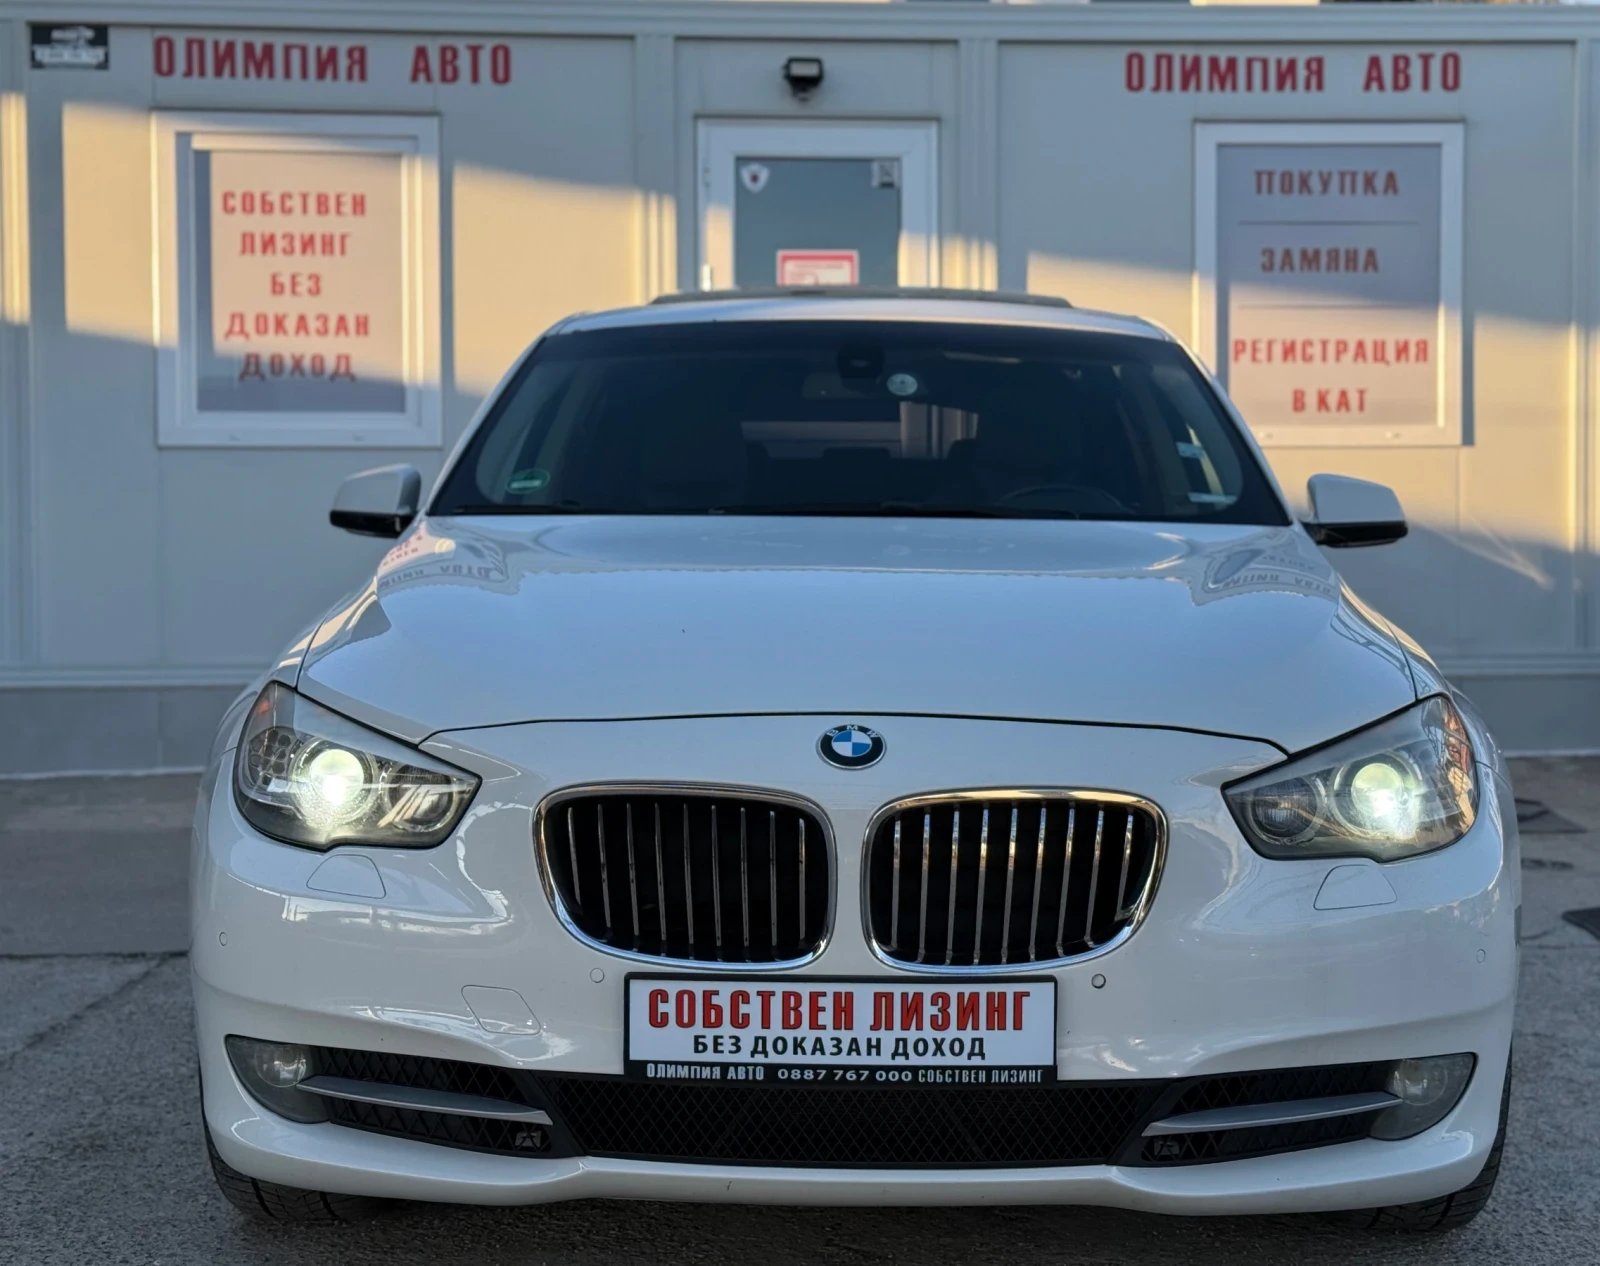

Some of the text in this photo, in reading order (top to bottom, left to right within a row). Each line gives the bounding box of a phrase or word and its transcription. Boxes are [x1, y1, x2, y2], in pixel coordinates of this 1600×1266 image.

[153, 36, 367, 82] ОЛИМПИЯ
[410, 44, 511, 84] АВТО
[1125, 52, 1461, 93] ОЛИМПИЯ АВТО
[1255, 169, 1399, 196] ПОКУПКА
[222, 190, 367, 217] СОБСТВЕН
[240, 232, 351, 257] ЛИЗИНГ
[1260, 247, 1379, 274] ЗАМЯНА
[270, 272, 323, 297] БЕЗ
[224, 312, 370, 340] ДОКАЗАН
[1233, 338, 1429, 367] РЕГИСТРАЦИЯ
[238, 352, 357, 382] ДОХОД
[1292, 388, 1368, 413] В КАТ
[826, 725, 880, 738] BMW
[649, 989, 1030, 1031] СОБСТВЕН ЛИЗИНГ
[693, 1035, 985, 1060] БЕЗ ДОКАЗАН ДОХОД
[646, 1063, 765, 1081] ОЛИМПИЯ АВТО
[777, 1069, 912, 1081] 0887 767 000
[918, 1069, 1043, 1084] СОБСТВЕН ЛИЗИНГ
